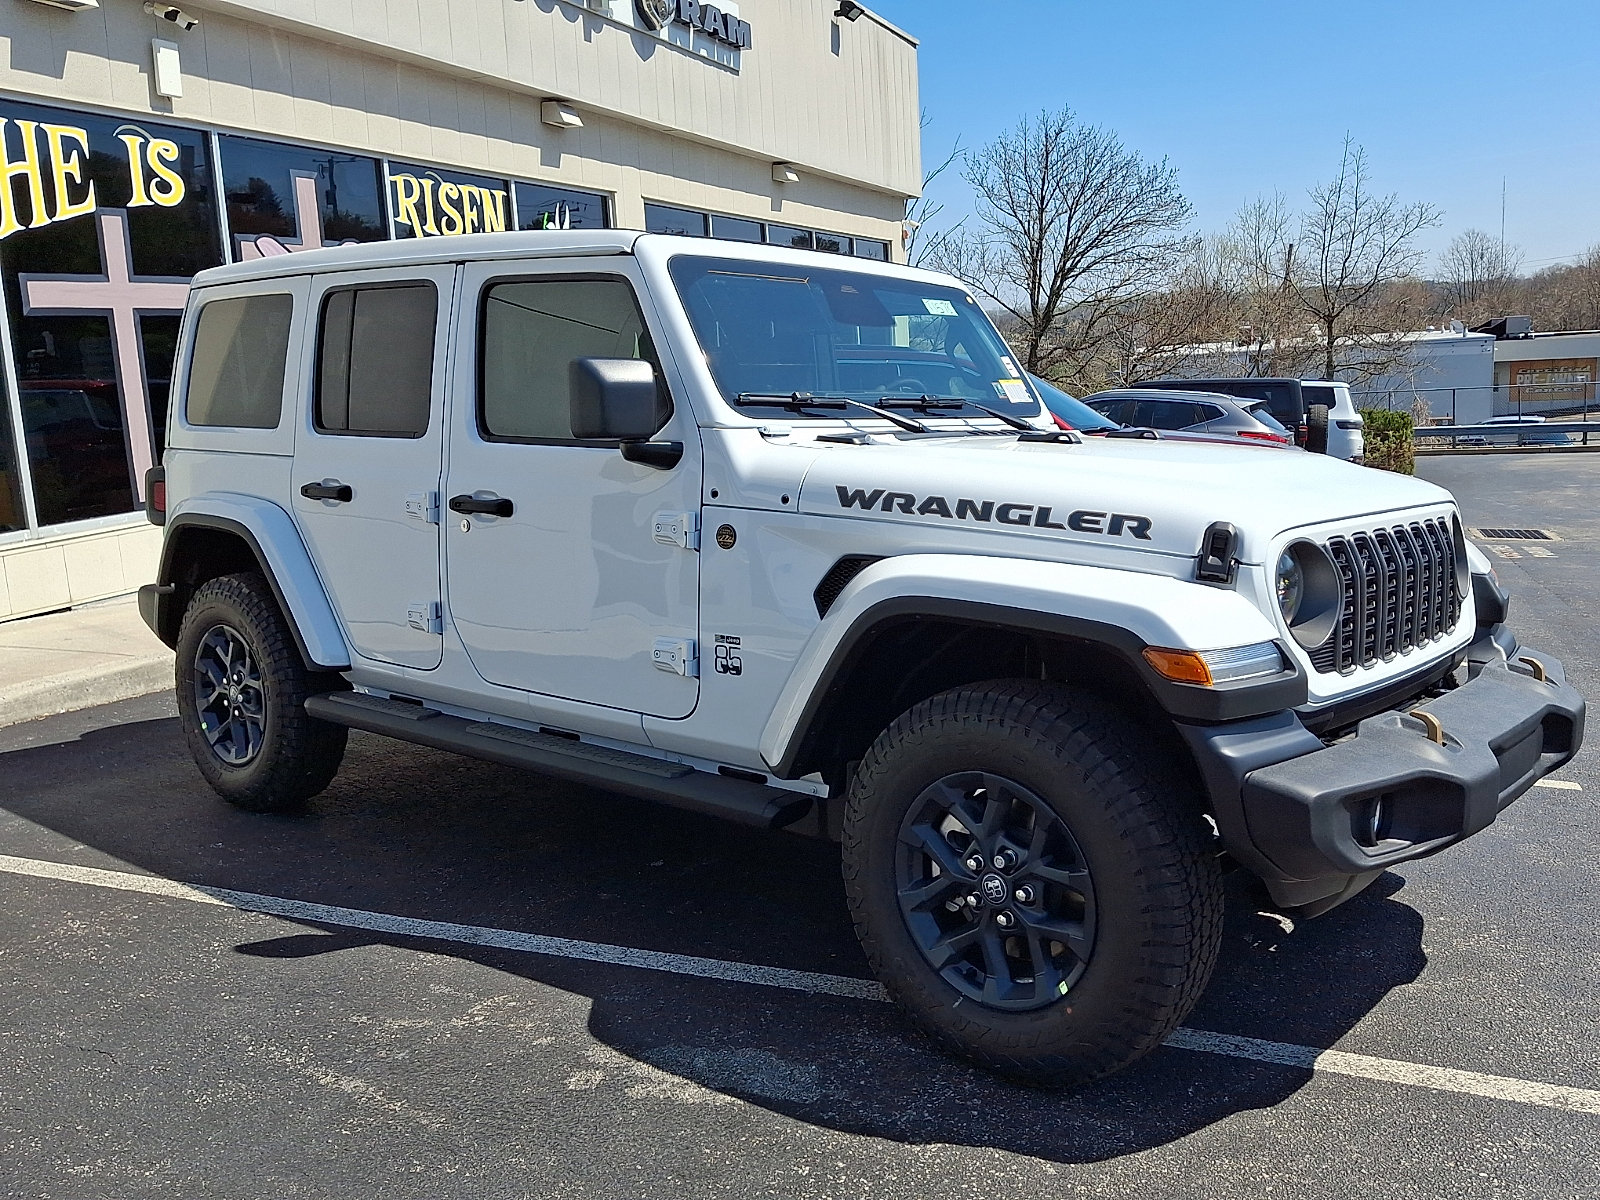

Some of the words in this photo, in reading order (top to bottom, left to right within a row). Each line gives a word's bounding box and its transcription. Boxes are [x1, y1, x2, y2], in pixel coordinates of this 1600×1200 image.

[677, 0, 752, 49] RAM
[0, 117, 97, 239] HE
[114, 127, 186, 207] IS
[389, 173, 507, 238] RISEN
[835, 485, 1152, 541] WRANGLER
[714, 644, 743, 676] 85
[726, 636, 741, 645] Jeep
